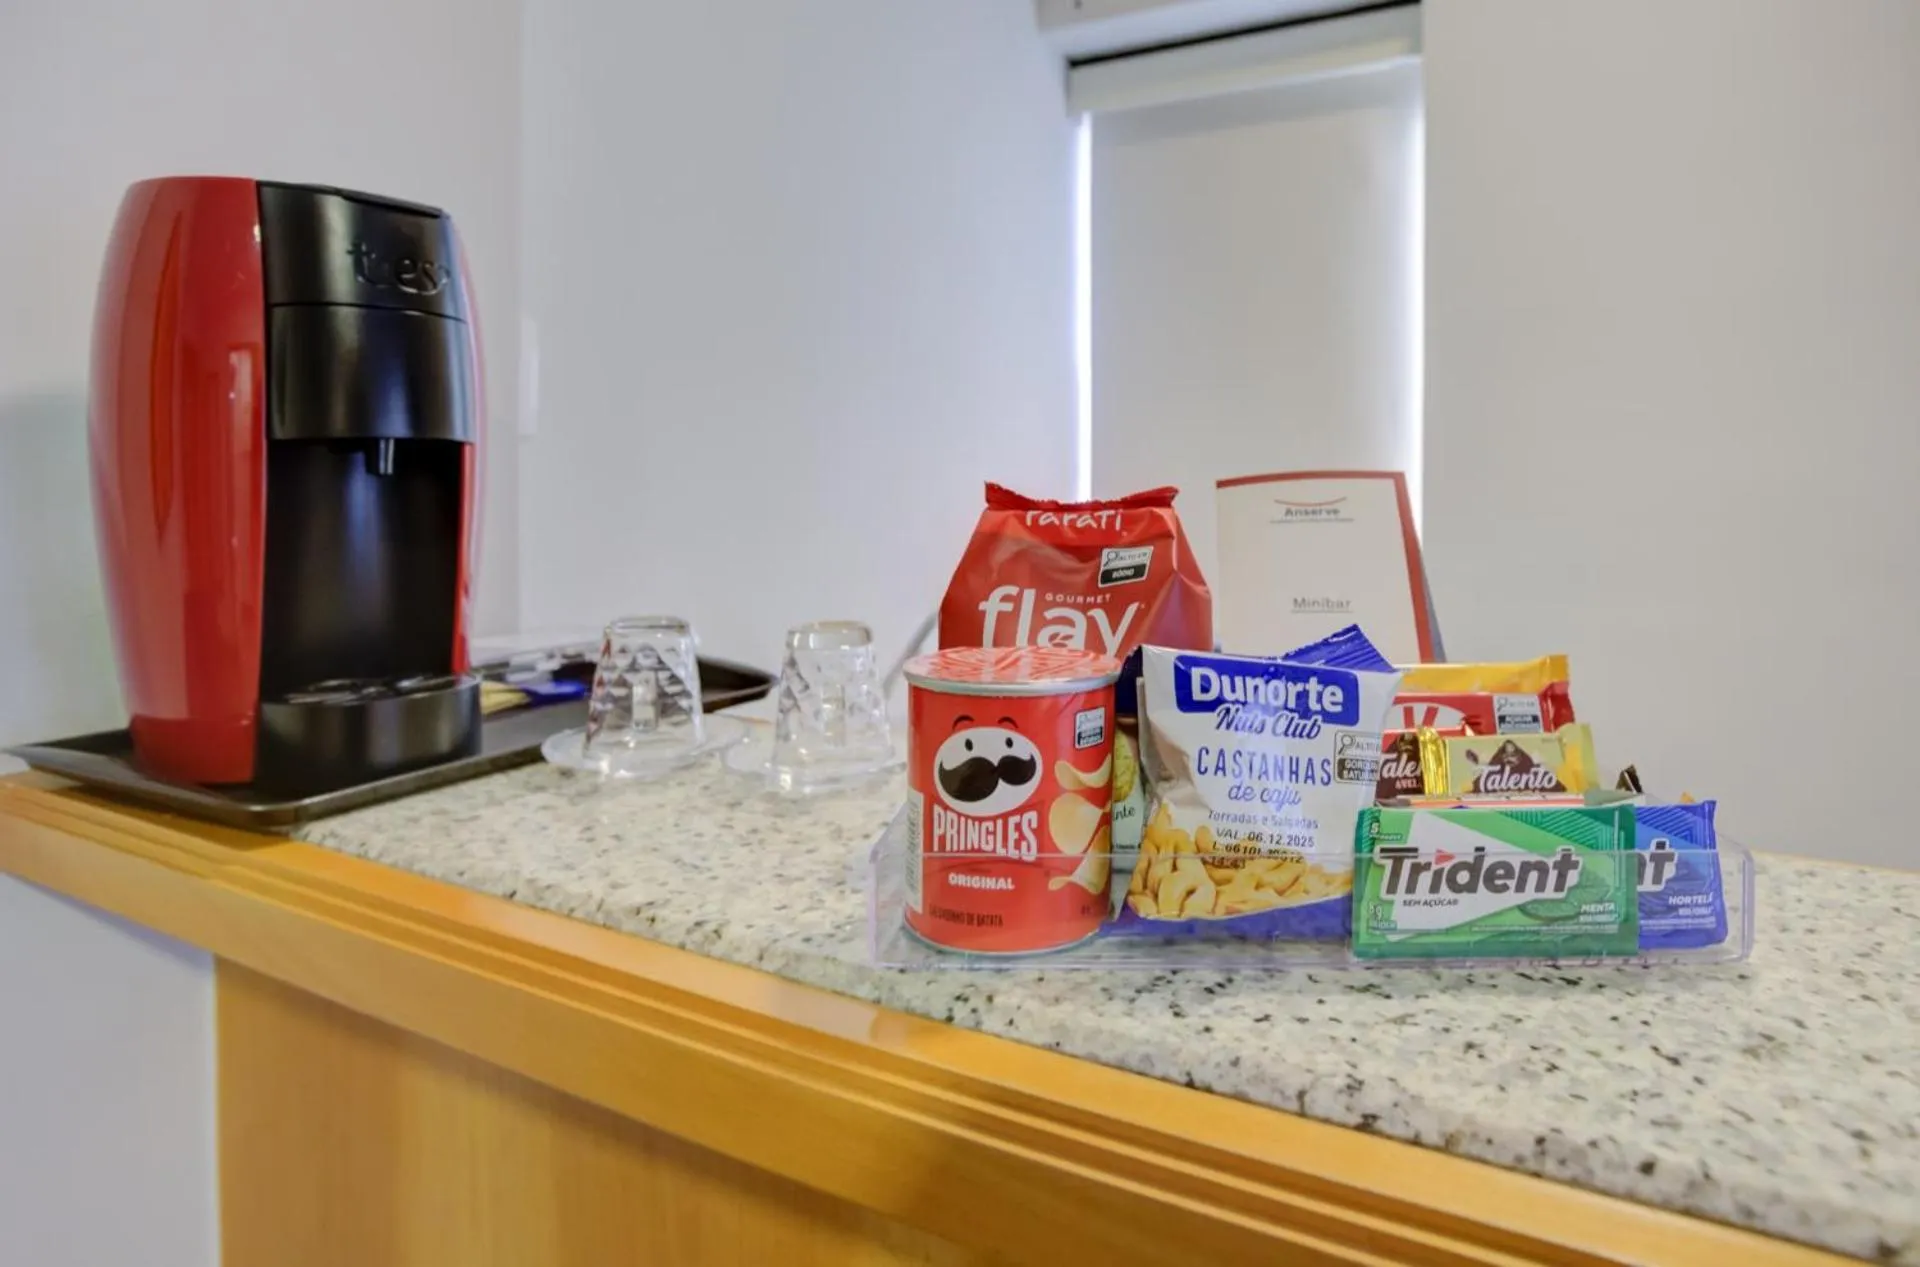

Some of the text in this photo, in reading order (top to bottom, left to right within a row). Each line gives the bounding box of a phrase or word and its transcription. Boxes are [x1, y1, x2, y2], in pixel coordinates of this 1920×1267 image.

[1044, 592, 1112, 604] GOURMET
[1293, 598, 1352, 609] Minibar
[978, 585, 1139, 659] flay
[1190, 666, 1344, 713] Dunorte
[1215, 704, 1322, 740] Nuts Club
[1197, 746, 1332, 787] CASTANHAS
[1479, 764, 1558, 791] Talento
[1228, 782, 1302, 812] de caju
[1208, 809, 1258, 825] Torradas
[932, 803, 1039, 863] PRINGLES
[948, 872, 1015, 890] ORIGINAL
[1379, 846, 1580, 895] Trident
[1581, 902, 1615, 913] MENTA
